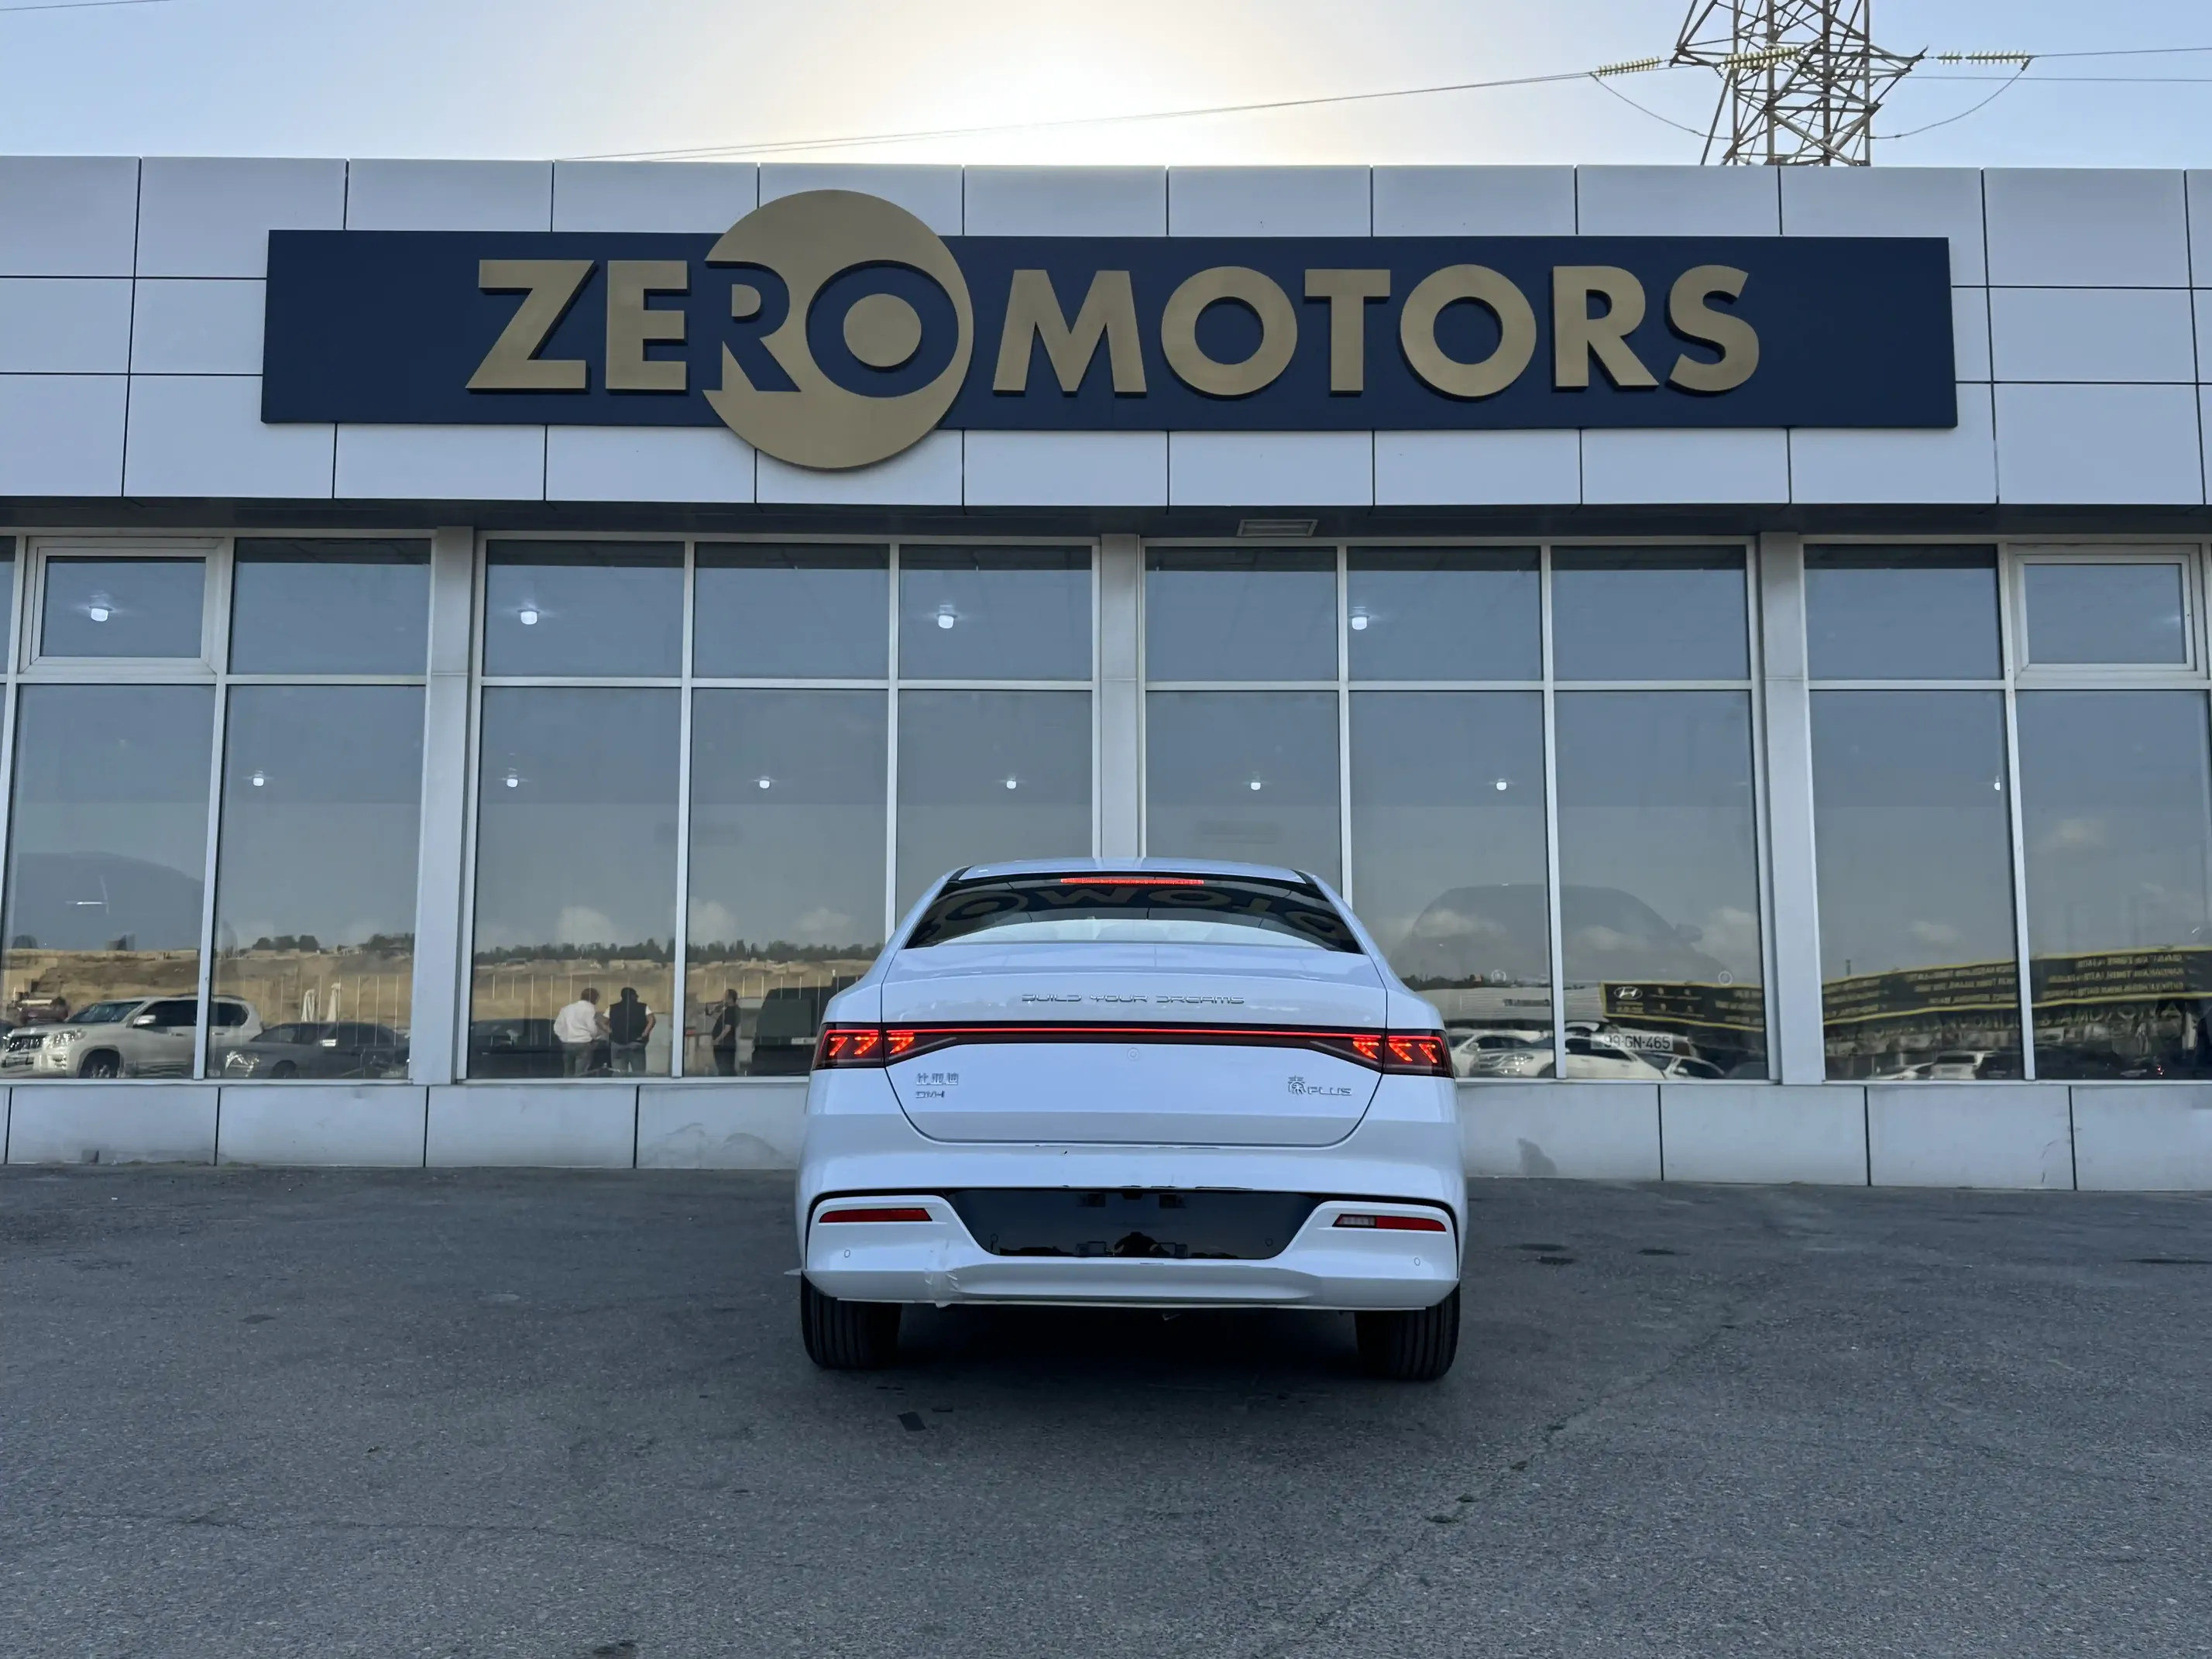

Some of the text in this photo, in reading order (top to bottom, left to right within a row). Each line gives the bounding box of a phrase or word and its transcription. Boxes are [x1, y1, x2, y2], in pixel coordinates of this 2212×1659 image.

[465, 259, 1761, 400] ZERO MOTORS
[1021, 994, 1245, 1005] BUILD YOUR DREAMS
[1307, 1086, 1352, 1097] PLUS
